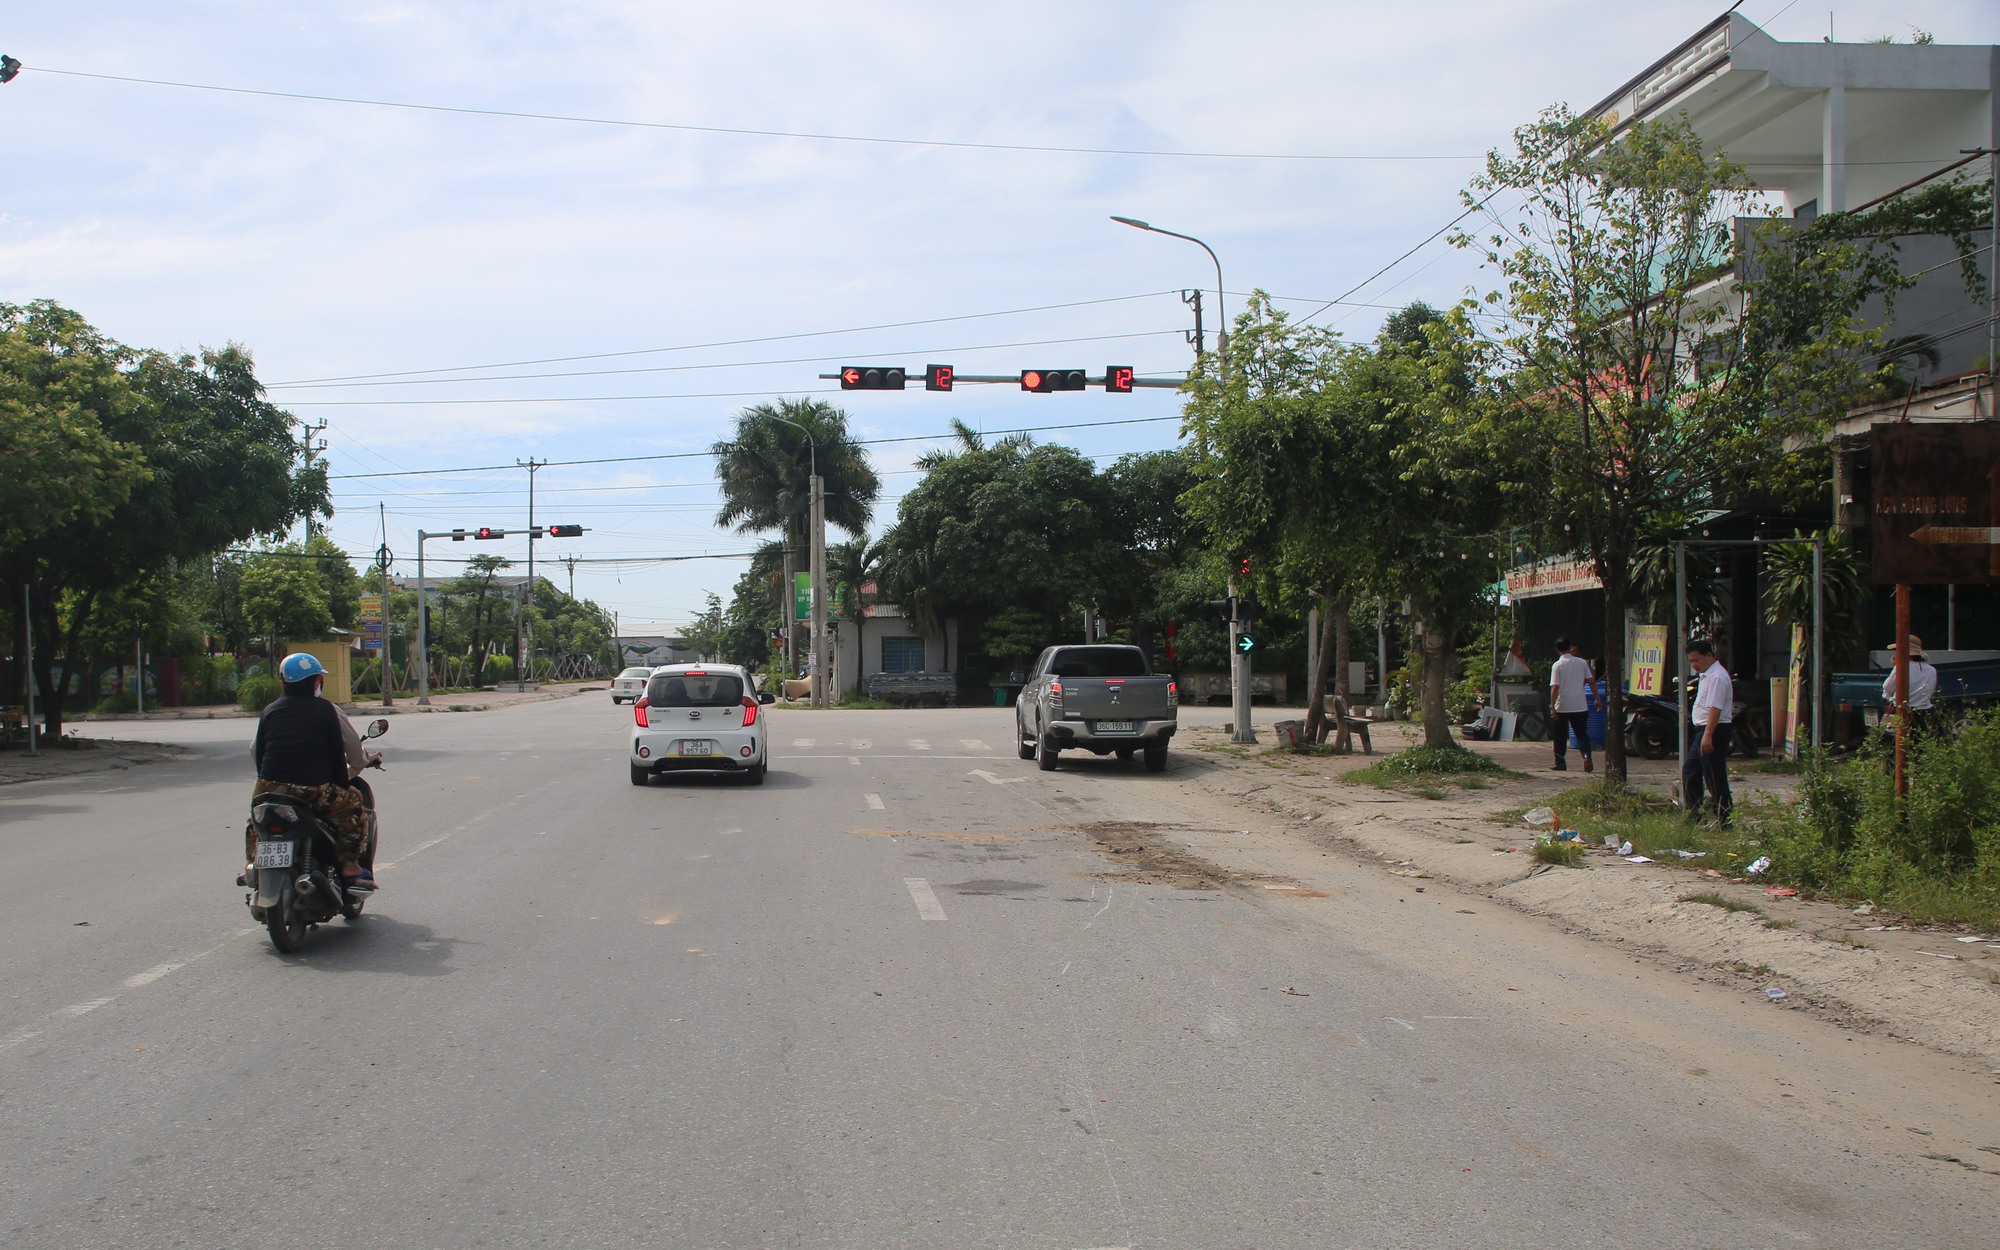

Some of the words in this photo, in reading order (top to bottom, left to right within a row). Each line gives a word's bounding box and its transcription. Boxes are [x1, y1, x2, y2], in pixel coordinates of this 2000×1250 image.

[936, 367, 952, 388] 12
[1116, 368, 1132, 389] 12
[1636, 667, 1654, 690] XE
[262, 843, 288, 855] 36-B3
